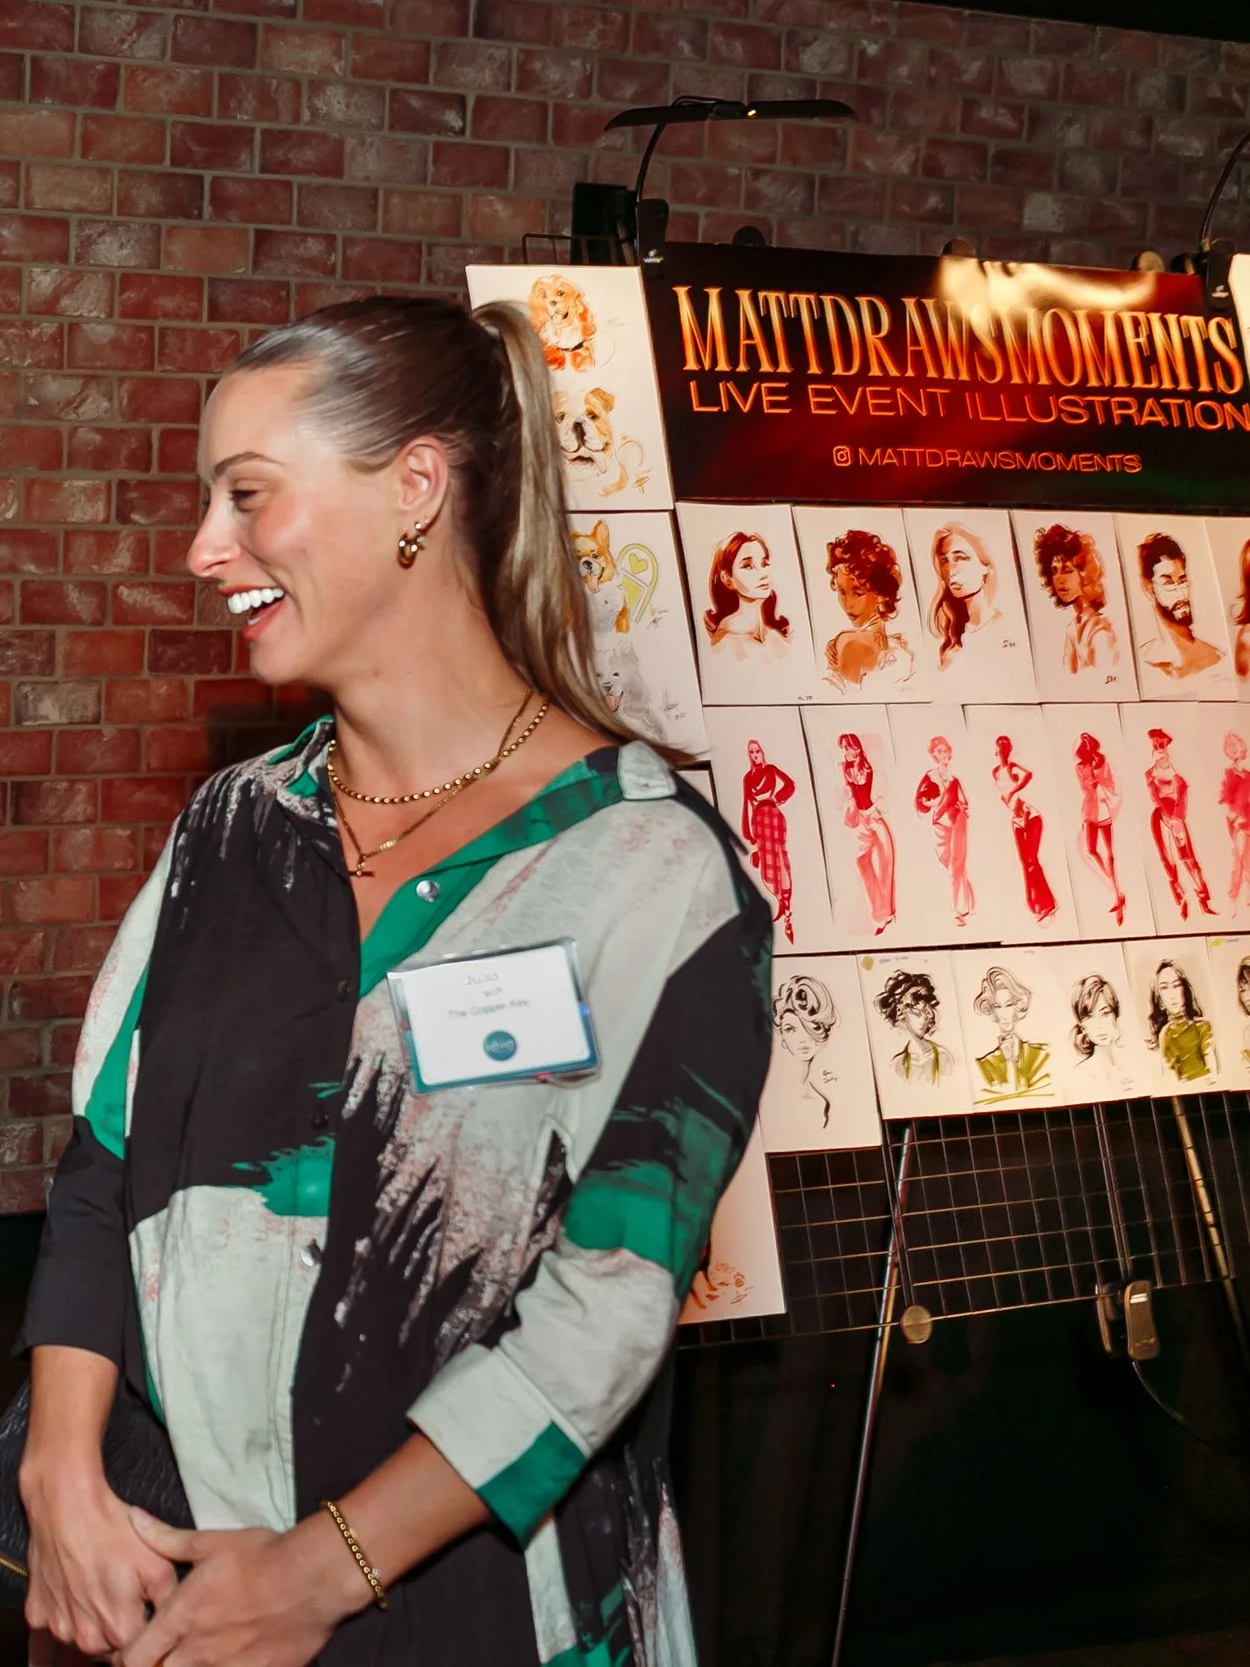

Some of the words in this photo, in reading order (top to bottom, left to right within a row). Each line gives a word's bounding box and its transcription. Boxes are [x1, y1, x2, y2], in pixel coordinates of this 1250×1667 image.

[672, 285, 1245, 395] MATTDRAWSMOMENTS
[689, 380, 793, 414] LIVE
[807, 384, 951, 417] EVENT
[964, 391, 1250, 432] ILLUSTRATION
[859, 447, 1143, 474] MATTDRAWSMOMENTS
